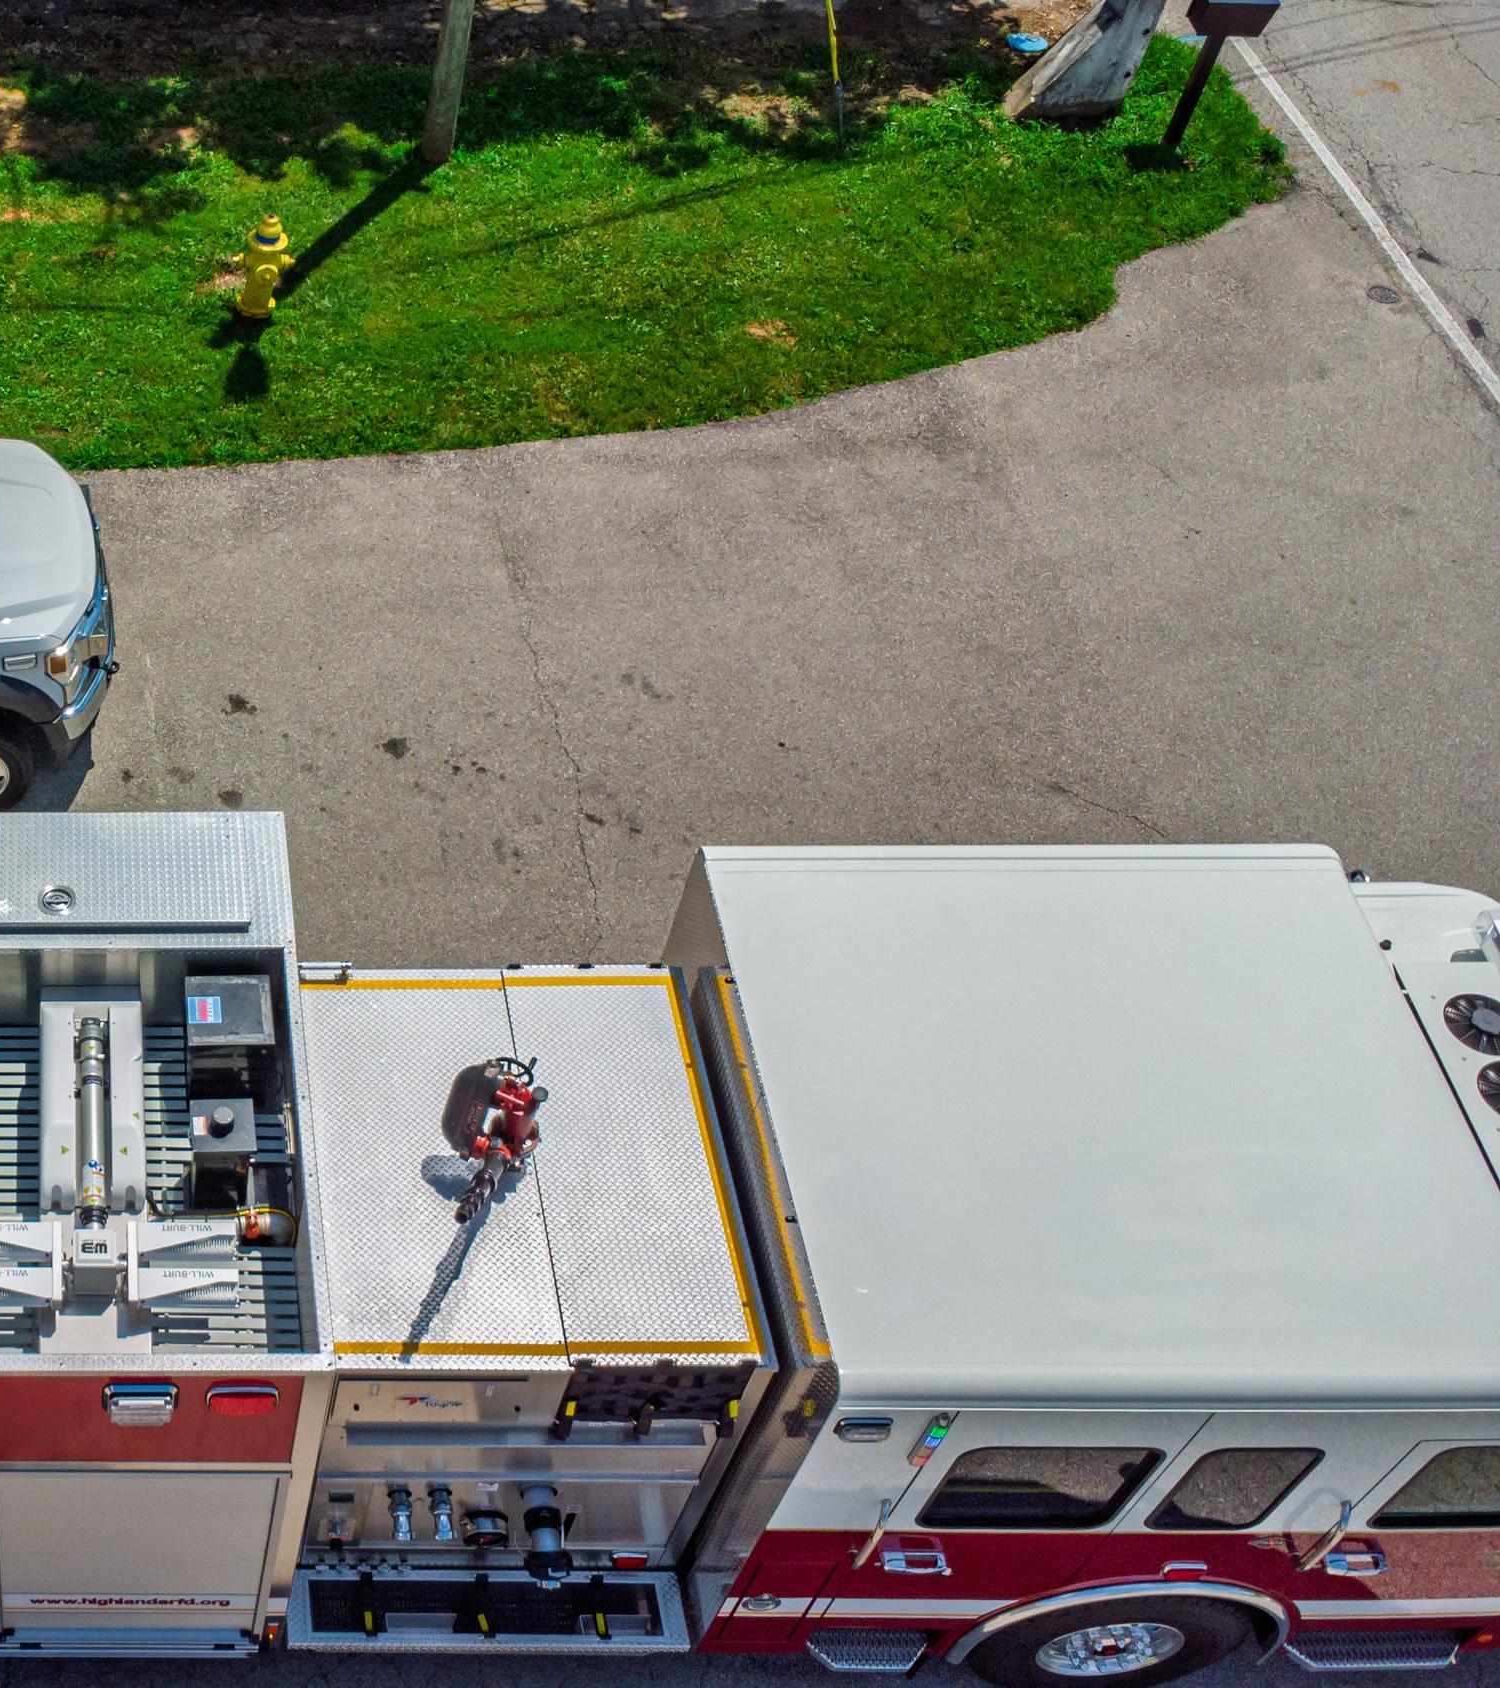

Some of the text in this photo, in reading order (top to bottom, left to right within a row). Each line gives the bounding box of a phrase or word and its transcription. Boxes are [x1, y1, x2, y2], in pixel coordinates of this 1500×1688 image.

[161, 1223, 213, 1232] WILL-BURT
[163, 1270, 215, 1278] WILL-BURT
[29, 1598, 231, 1607] www.highlanderfd.org
